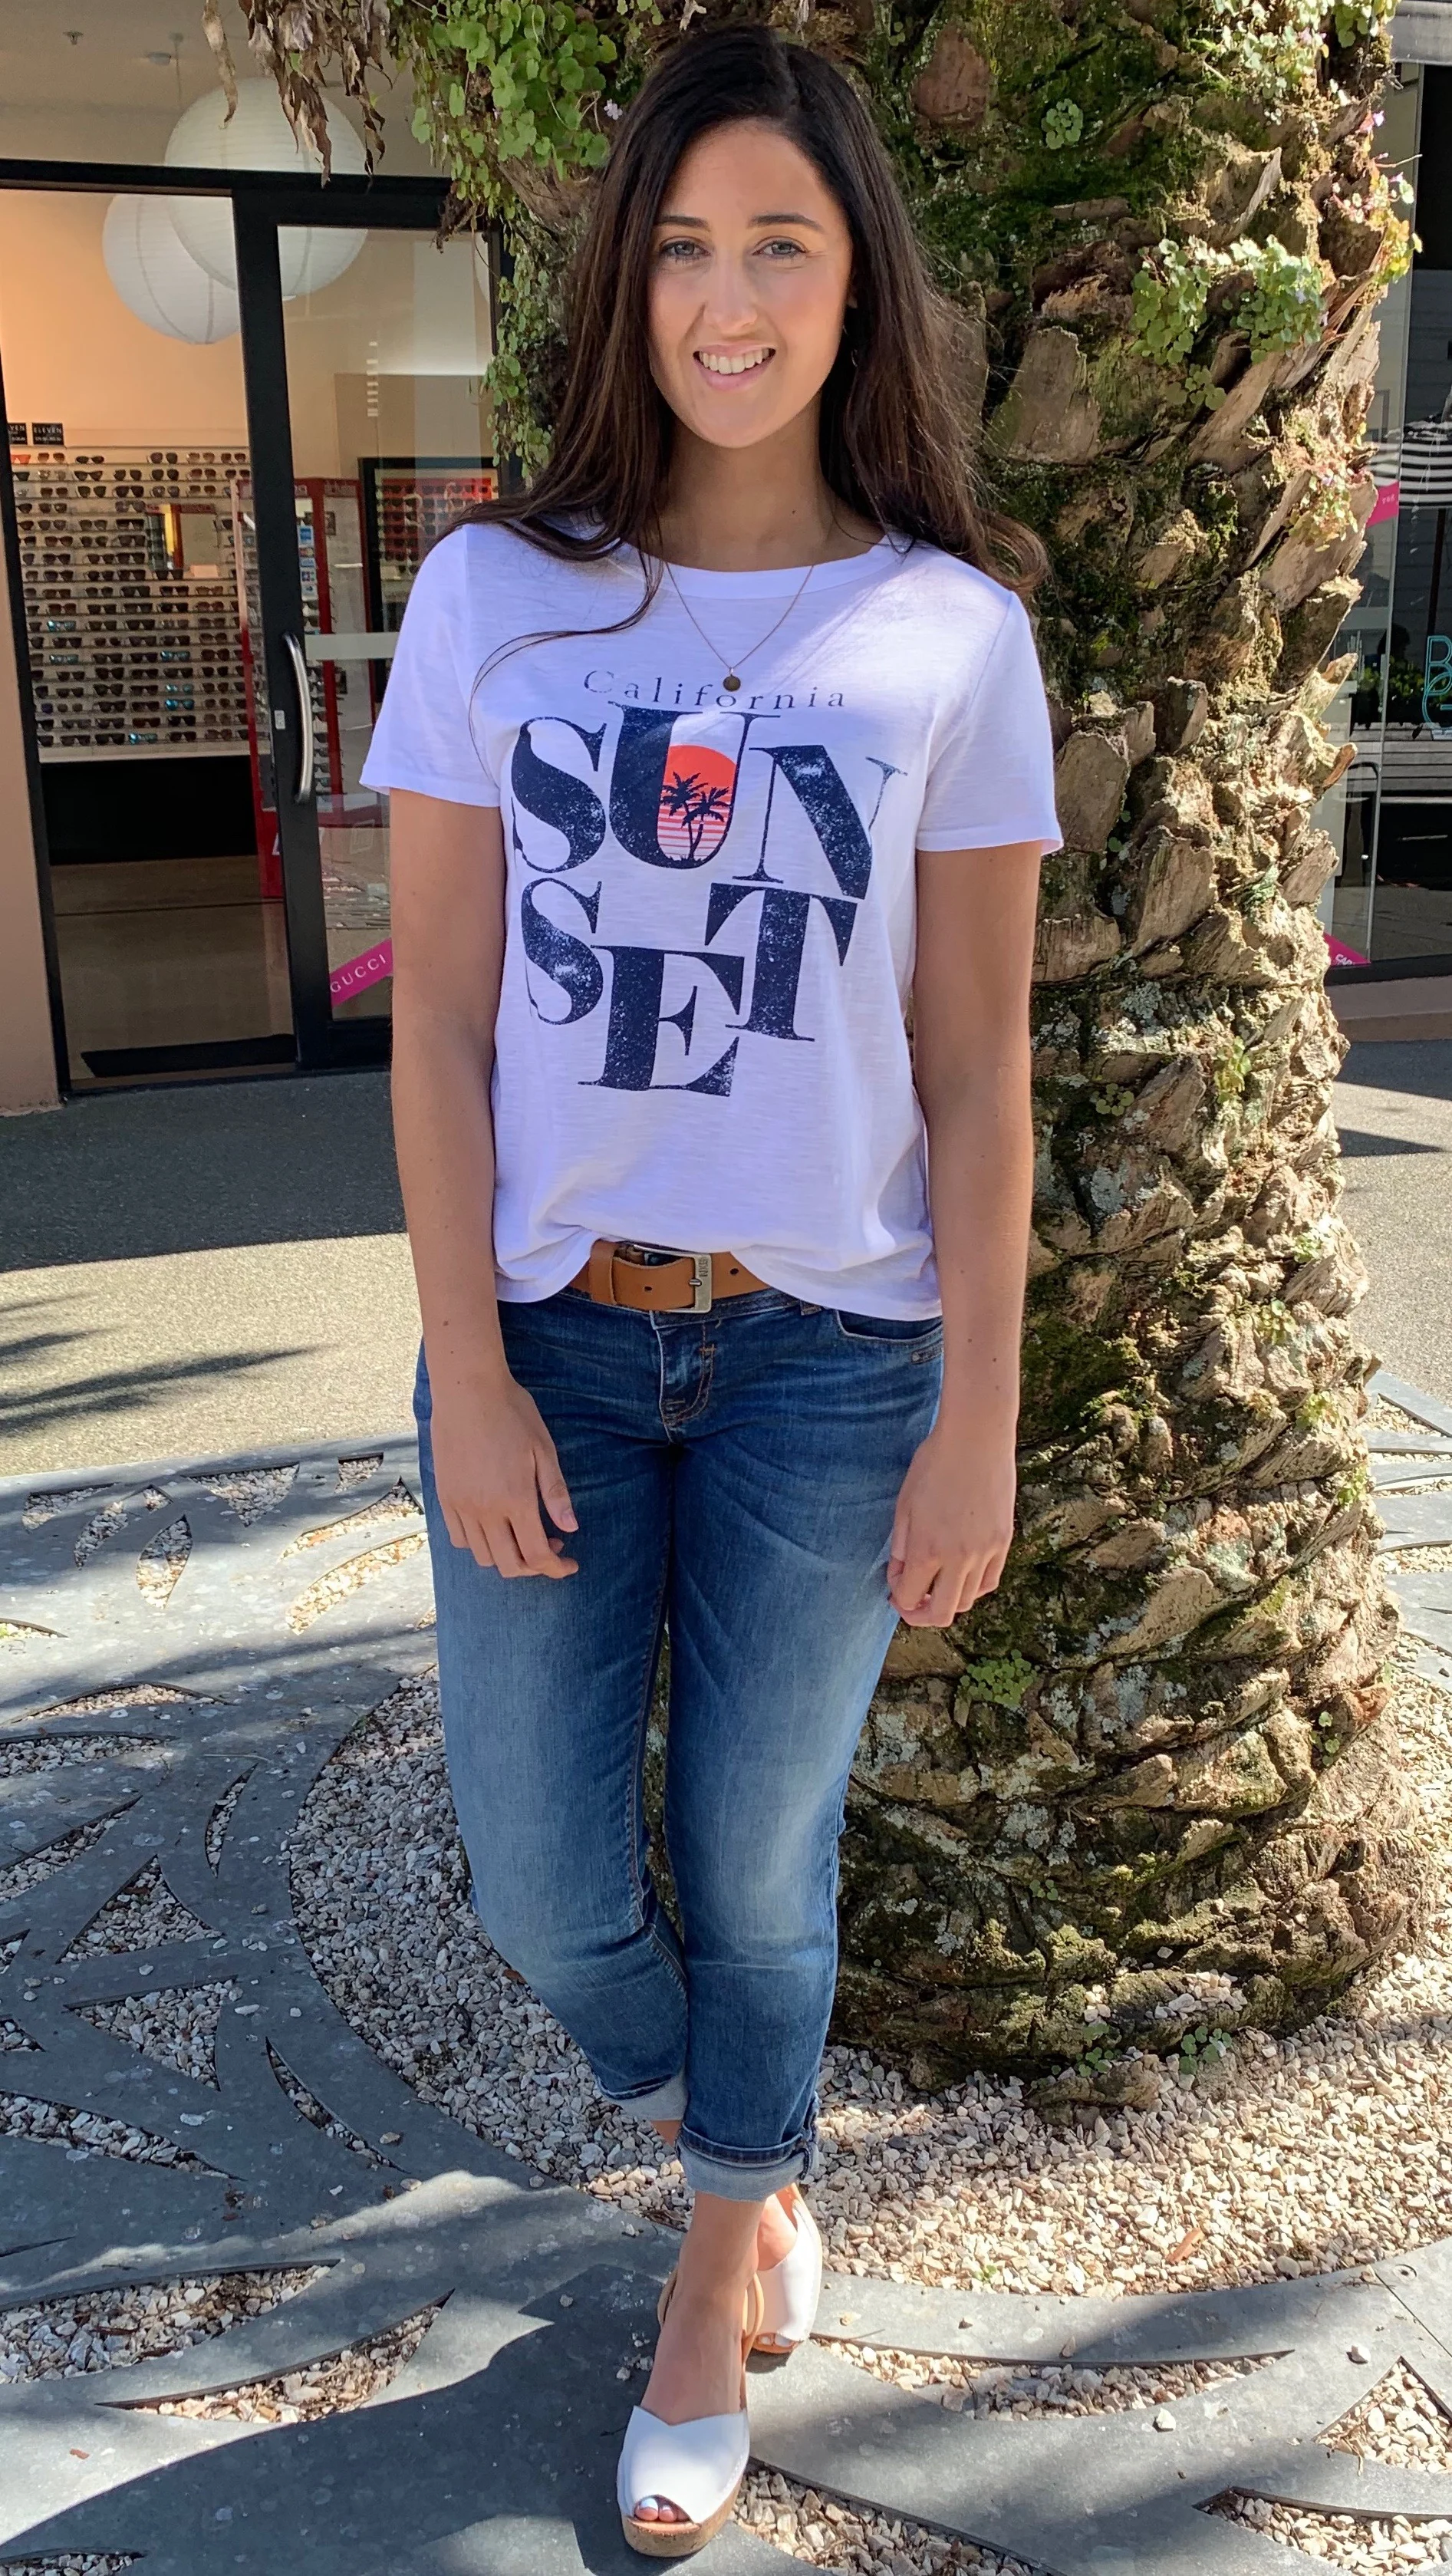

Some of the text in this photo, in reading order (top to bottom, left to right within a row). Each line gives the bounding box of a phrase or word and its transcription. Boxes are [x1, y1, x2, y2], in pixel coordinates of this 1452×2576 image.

[584, 670, 845, 710] California
[511, 700, 908, 900] SUN
[330, 954, 386, 993] GUCCI
[521, 878, 858, 1097] SET
